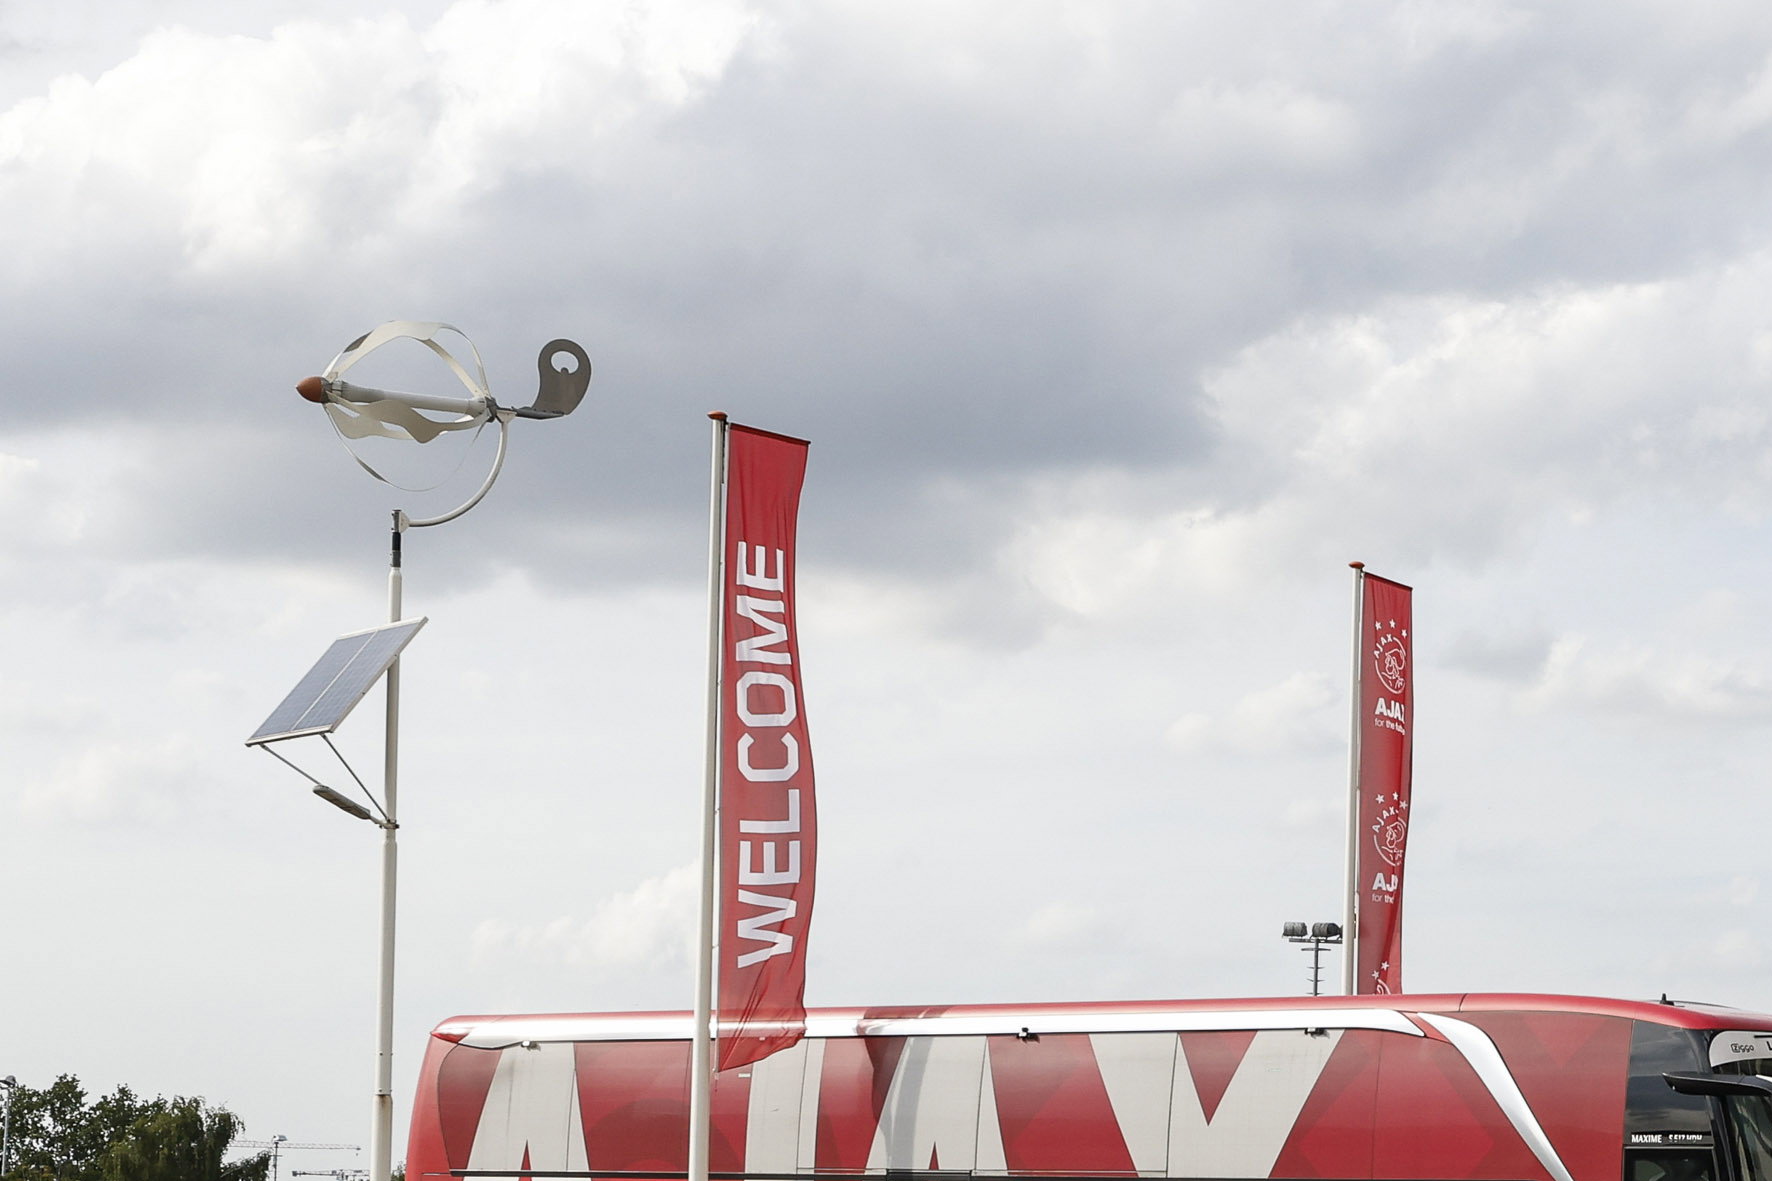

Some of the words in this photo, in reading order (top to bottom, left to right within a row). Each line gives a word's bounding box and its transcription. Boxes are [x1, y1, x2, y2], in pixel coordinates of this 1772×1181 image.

[1374, 634, 1393, 659] AJAX
[1375, 718, 1384, 727] for
[735, 540, 800, 969] WELCOME
[1372, 806, 1395, 833] AJAX
[1631, 1134, 1662, 1143] MAXIME
